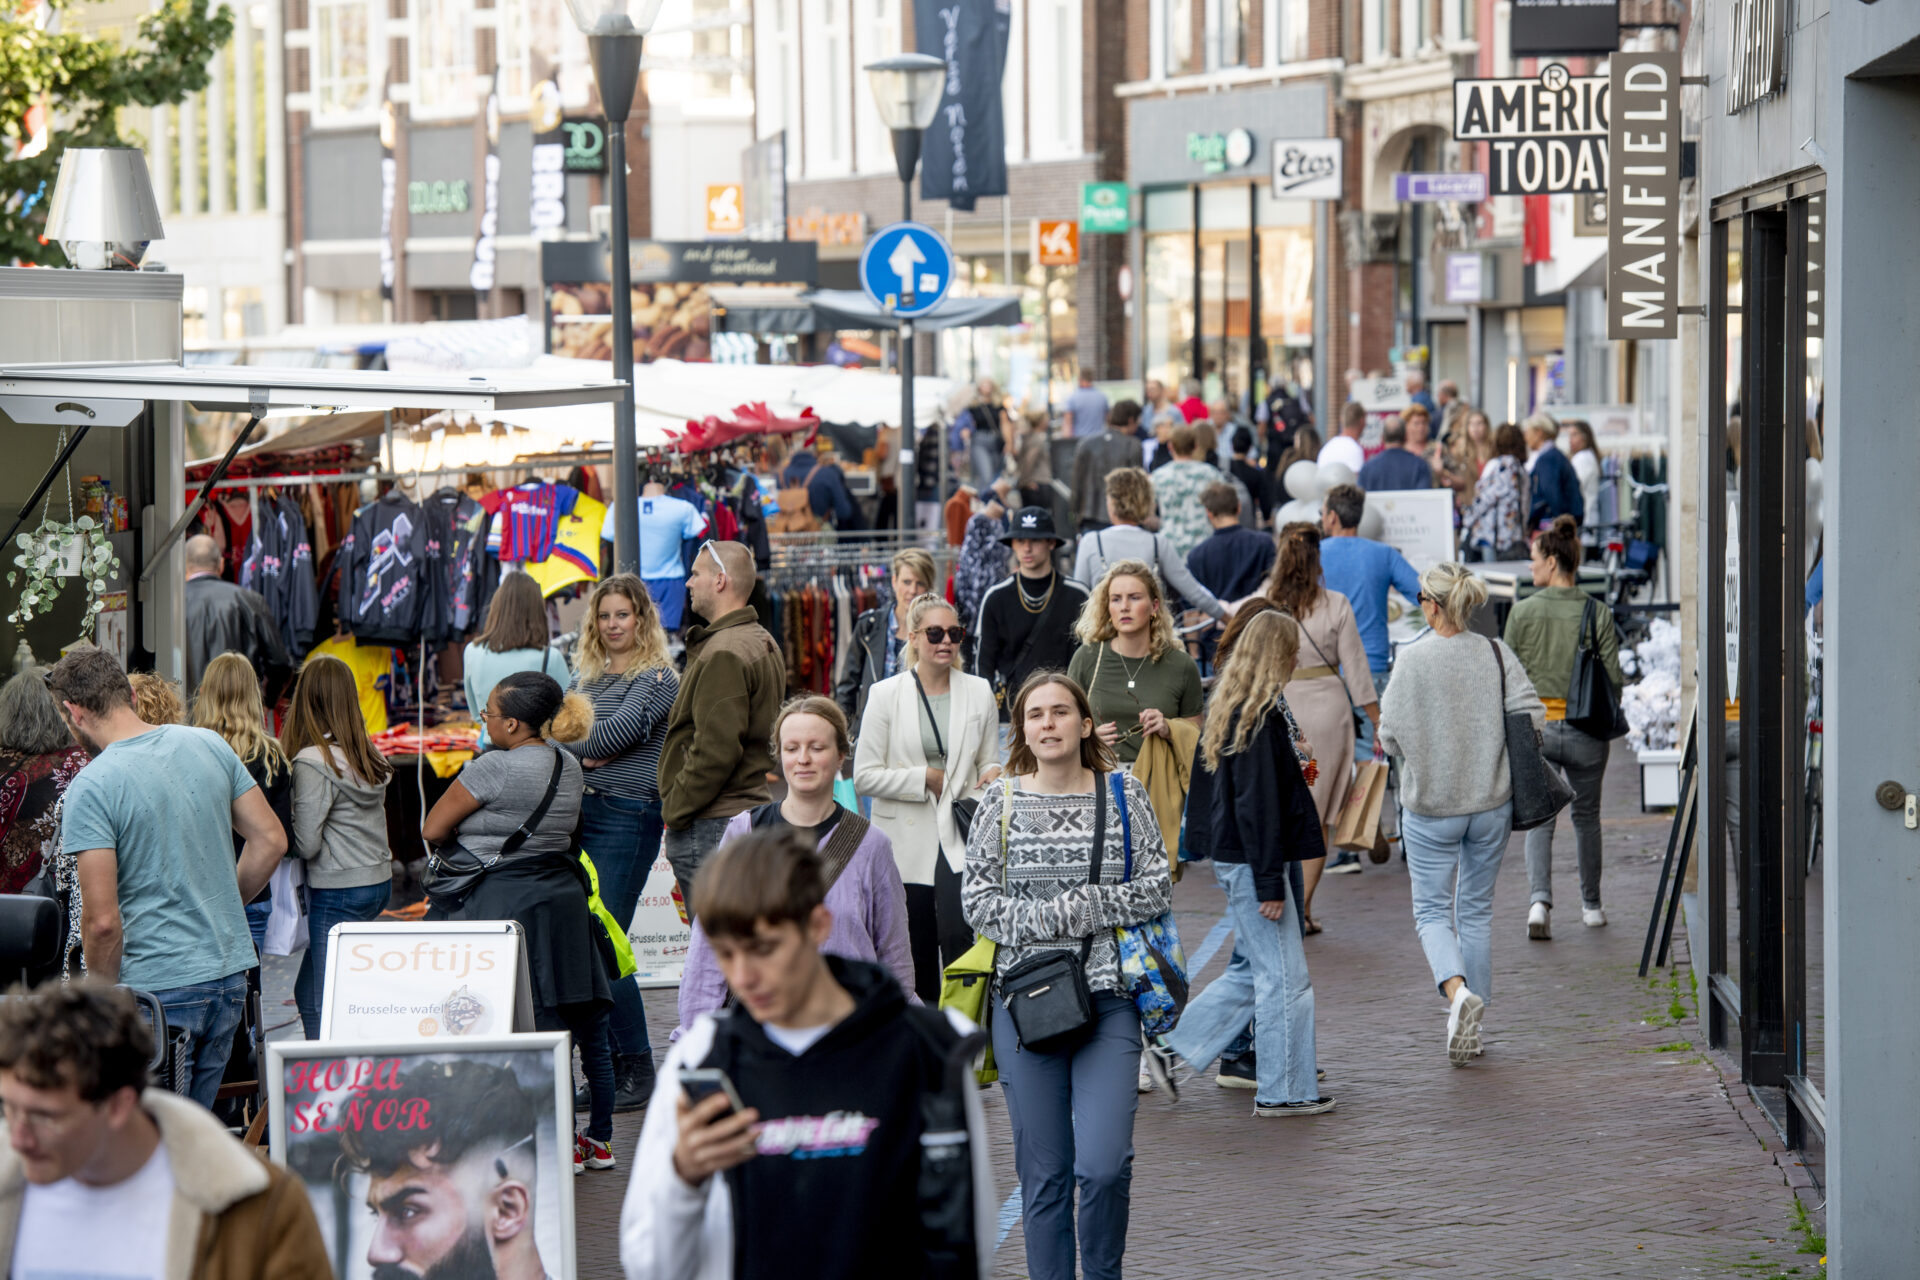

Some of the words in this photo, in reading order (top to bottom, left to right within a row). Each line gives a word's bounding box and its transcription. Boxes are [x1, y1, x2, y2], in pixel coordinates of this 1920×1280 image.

[1280, 148, 1336, 179] Etos
[1622, 62, 1669, 328] MANFIELD
[630, 932, 667, 944] Brusselse
[349, 942, 495, 979] Softijs
[348, 1004, 407, 1015] Brusselse
[285, 1058, 403, 1094] HOLA
[290, 1092, 432, 1134] SEÑOR
